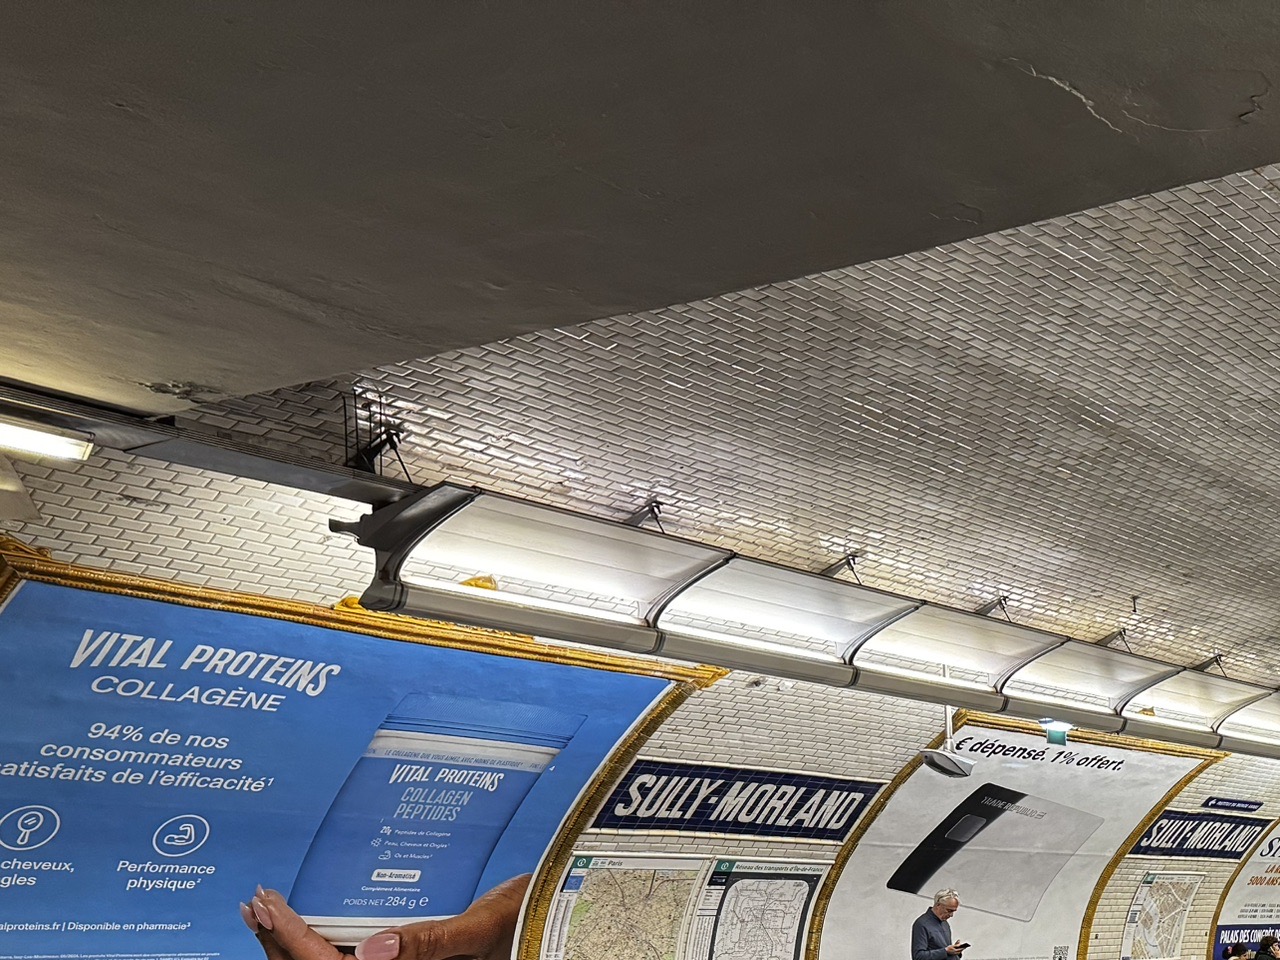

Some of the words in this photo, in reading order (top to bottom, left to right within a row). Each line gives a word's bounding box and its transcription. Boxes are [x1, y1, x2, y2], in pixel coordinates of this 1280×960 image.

[69, 629, 173, 669] VITAL
[180, 644, 341, 697] PROTEINS
[90, 675, 286, 712] COLLAGÈNE
[87, 722, 143, 742] 94%
[149, 728, 181, 745] de
[185, 734, 230, 749] nos
[40, 743, 243, 770] consommateurs
[955, 736, 974, 750] €
[969, 739, 1050, 762] dépensé.
[1050, 751, 1078, 767] 1%
[1076, 755, 1125, 771] offert.
[0, 761, 107, 783] atisfaits
[111, 768, 144, 785] de
[388, 764, 430, 784] VITAL
[434, 768, 505, 793] PROTEINS
[400, 787, 474, 806] COLLAGEN
[613, 772, 864, 831] SULLY-MORLAND
[393, 803, 461, 822] PEPTIDES
[980, 796, 1007, 808] TRADE
[1002, 803, 1038, 818] REPUBLIC
[1140, 819, 1262, 852] SULLY-MORLAND
[0, 858, 75, 873] cheveux,
[116, 861, 216, 875] Performance
[735, 863, 752, 871] Réseau
[764, 865, 788, 873] transports
[1265, 864, 1275, 873] LA
[1247, 876, 1267, 885] 5000
[1267, 877, 1279, 885] ANS
[343, 898, 367, 906] POIDS
[385, 896, 407, 906] 284
[408, 899, 417, 909] g
[67, 921, 121, 932] Disponible
[1220, 930, 1239, 944] PALAIS
[1239, 929, 1249, 943] DES
